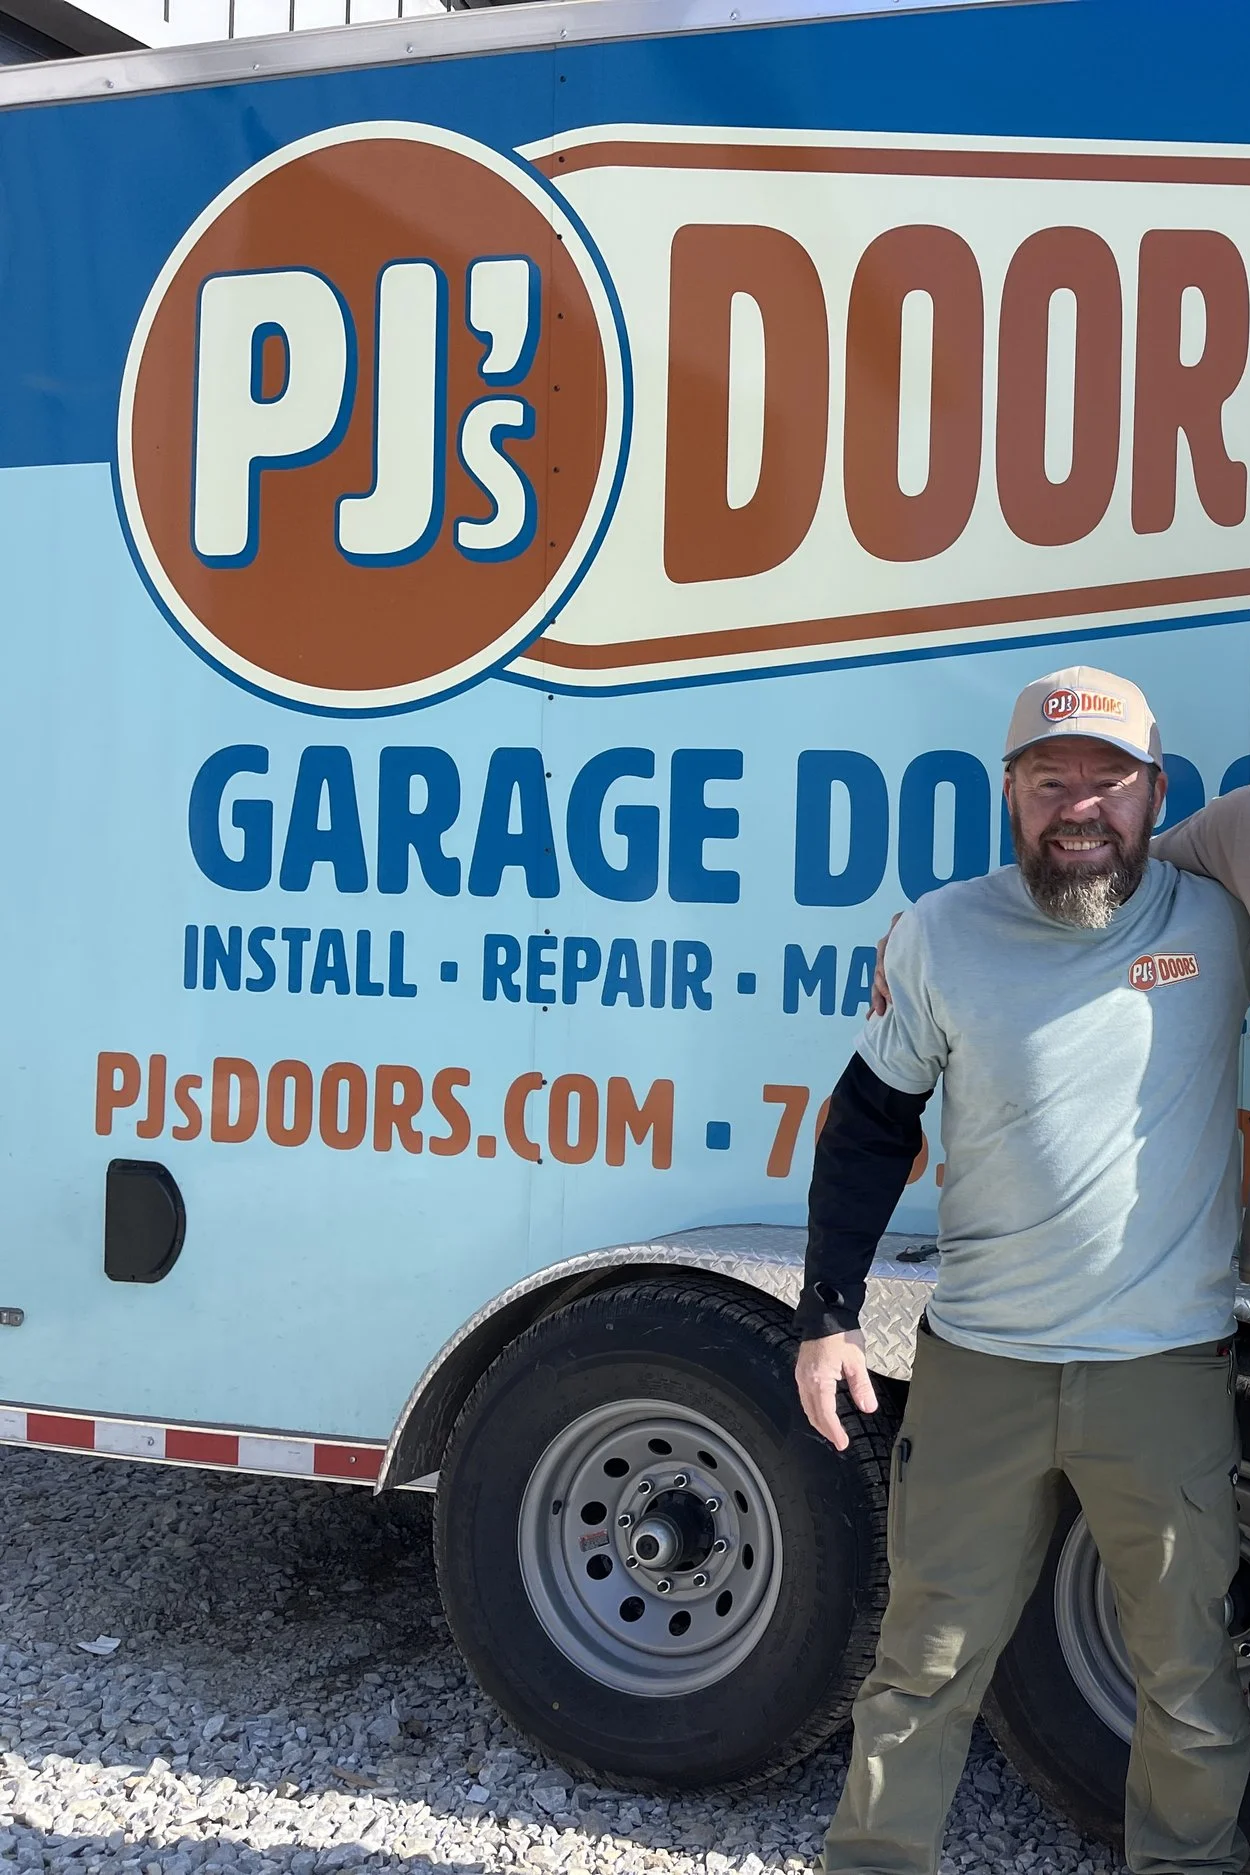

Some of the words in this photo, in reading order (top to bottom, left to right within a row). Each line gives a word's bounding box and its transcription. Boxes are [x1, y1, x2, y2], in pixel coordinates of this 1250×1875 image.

[192, 258, 535, 564] PJ's
[1081, 693, 1122, 714] DOORS
[188, 744, 744, 904] GARAGE
[183, 924, 418, 998] INSTALL
[482, 933, 713, 1011] REPAIR
[1158, 957, 1197, 981] DOORS
